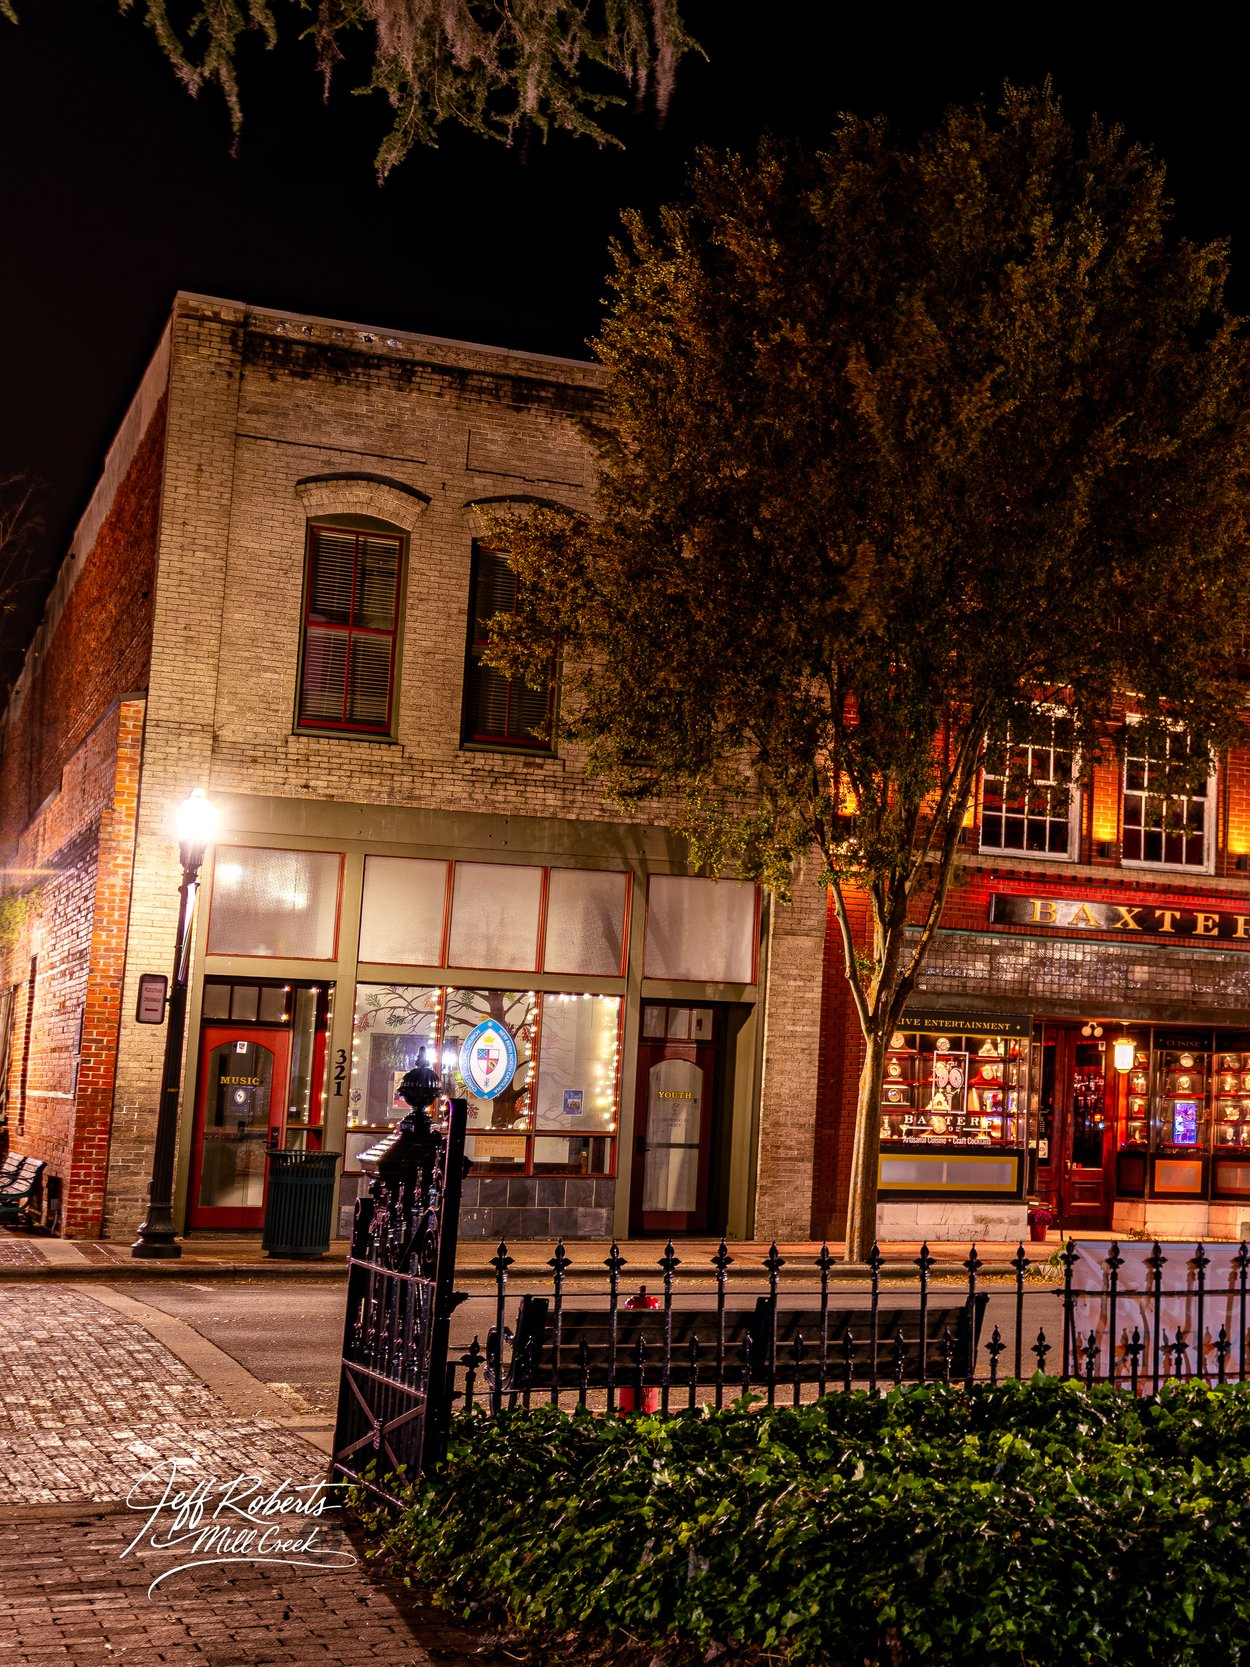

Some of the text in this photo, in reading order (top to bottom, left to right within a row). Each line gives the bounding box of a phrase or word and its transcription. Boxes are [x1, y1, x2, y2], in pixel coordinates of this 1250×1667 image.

[924, 1019, 1011, 1031] ENTERTAINMENT
[220, 1076, 260, 1085] MUSIC
[658, 1091, 692, 1099] YOUTH
[952, 1137, 966, 1145] Craft
